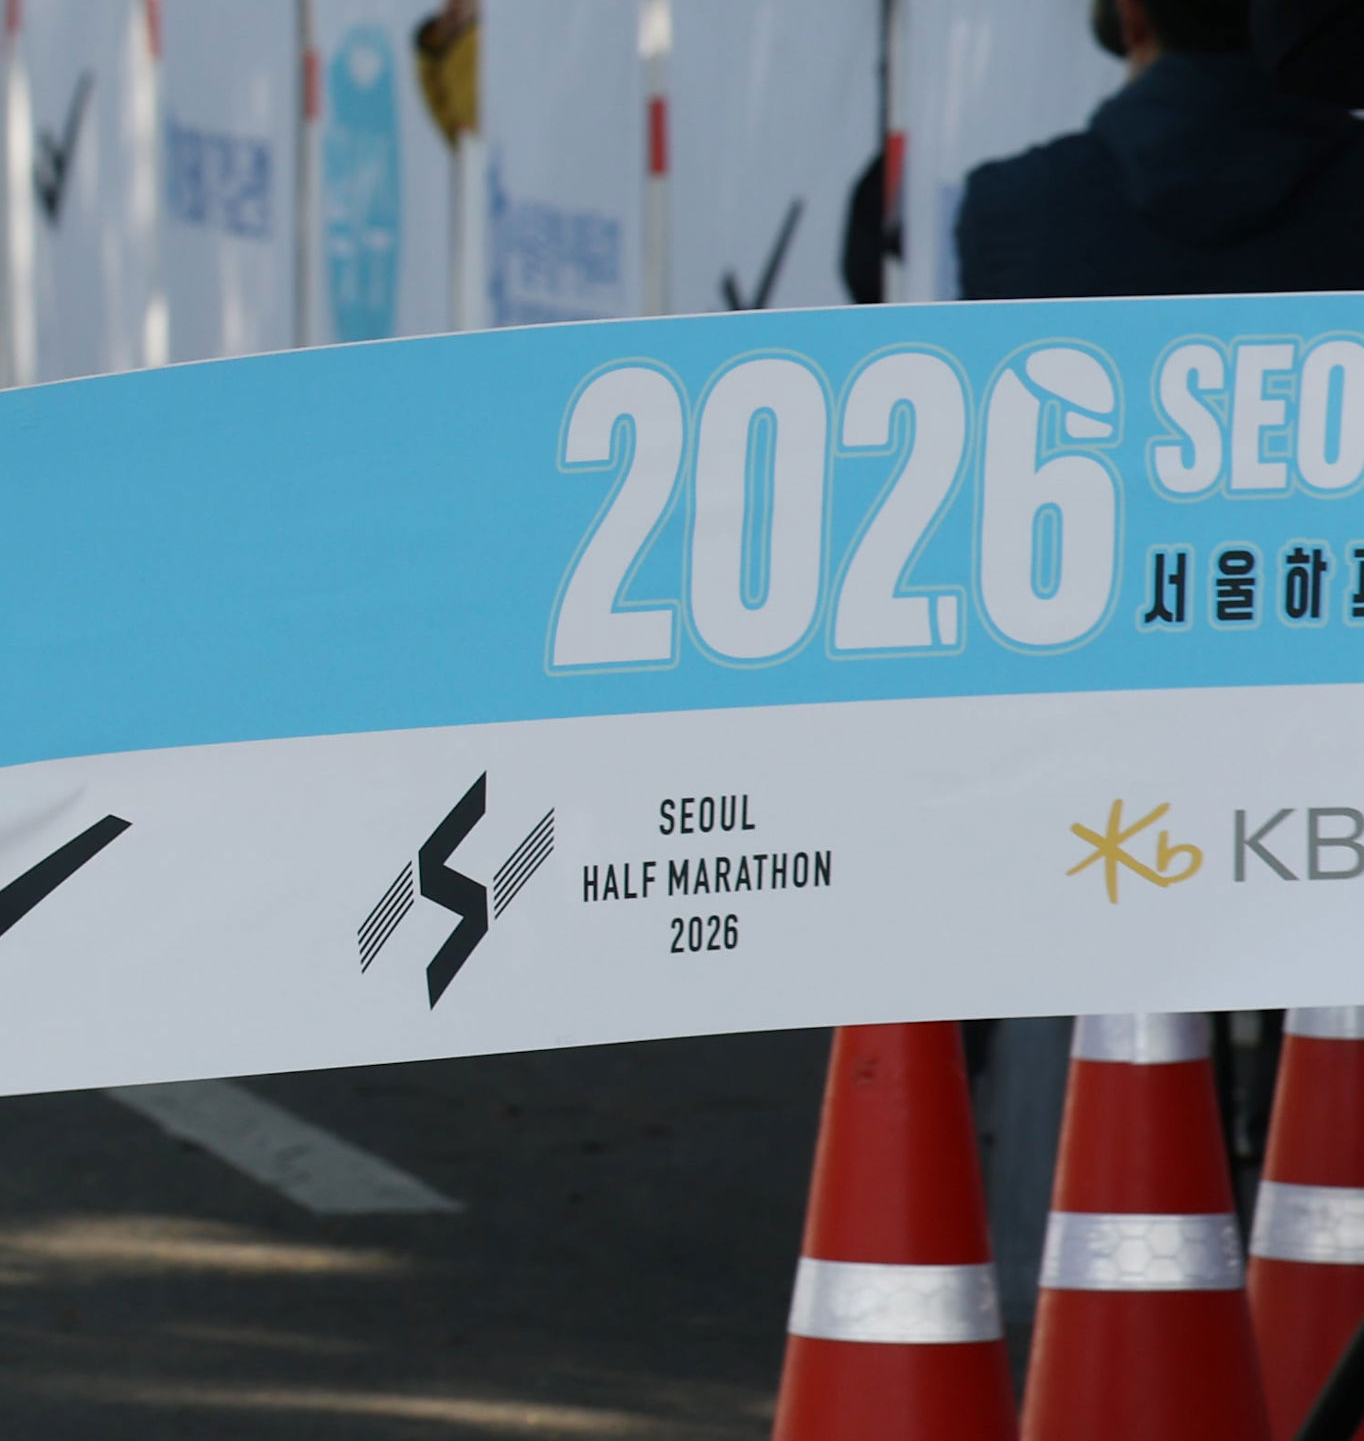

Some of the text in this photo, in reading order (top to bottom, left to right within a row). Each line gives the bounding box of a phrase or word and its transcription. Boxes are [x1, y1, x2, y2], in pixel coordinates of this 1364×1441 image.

[552, 346, 1115, 666] 2026
[658, 794, 756, 836] SEOUL
[582, 850, 833, 903] HALF MARATHON
[670, 913, 740, 955] 2026
